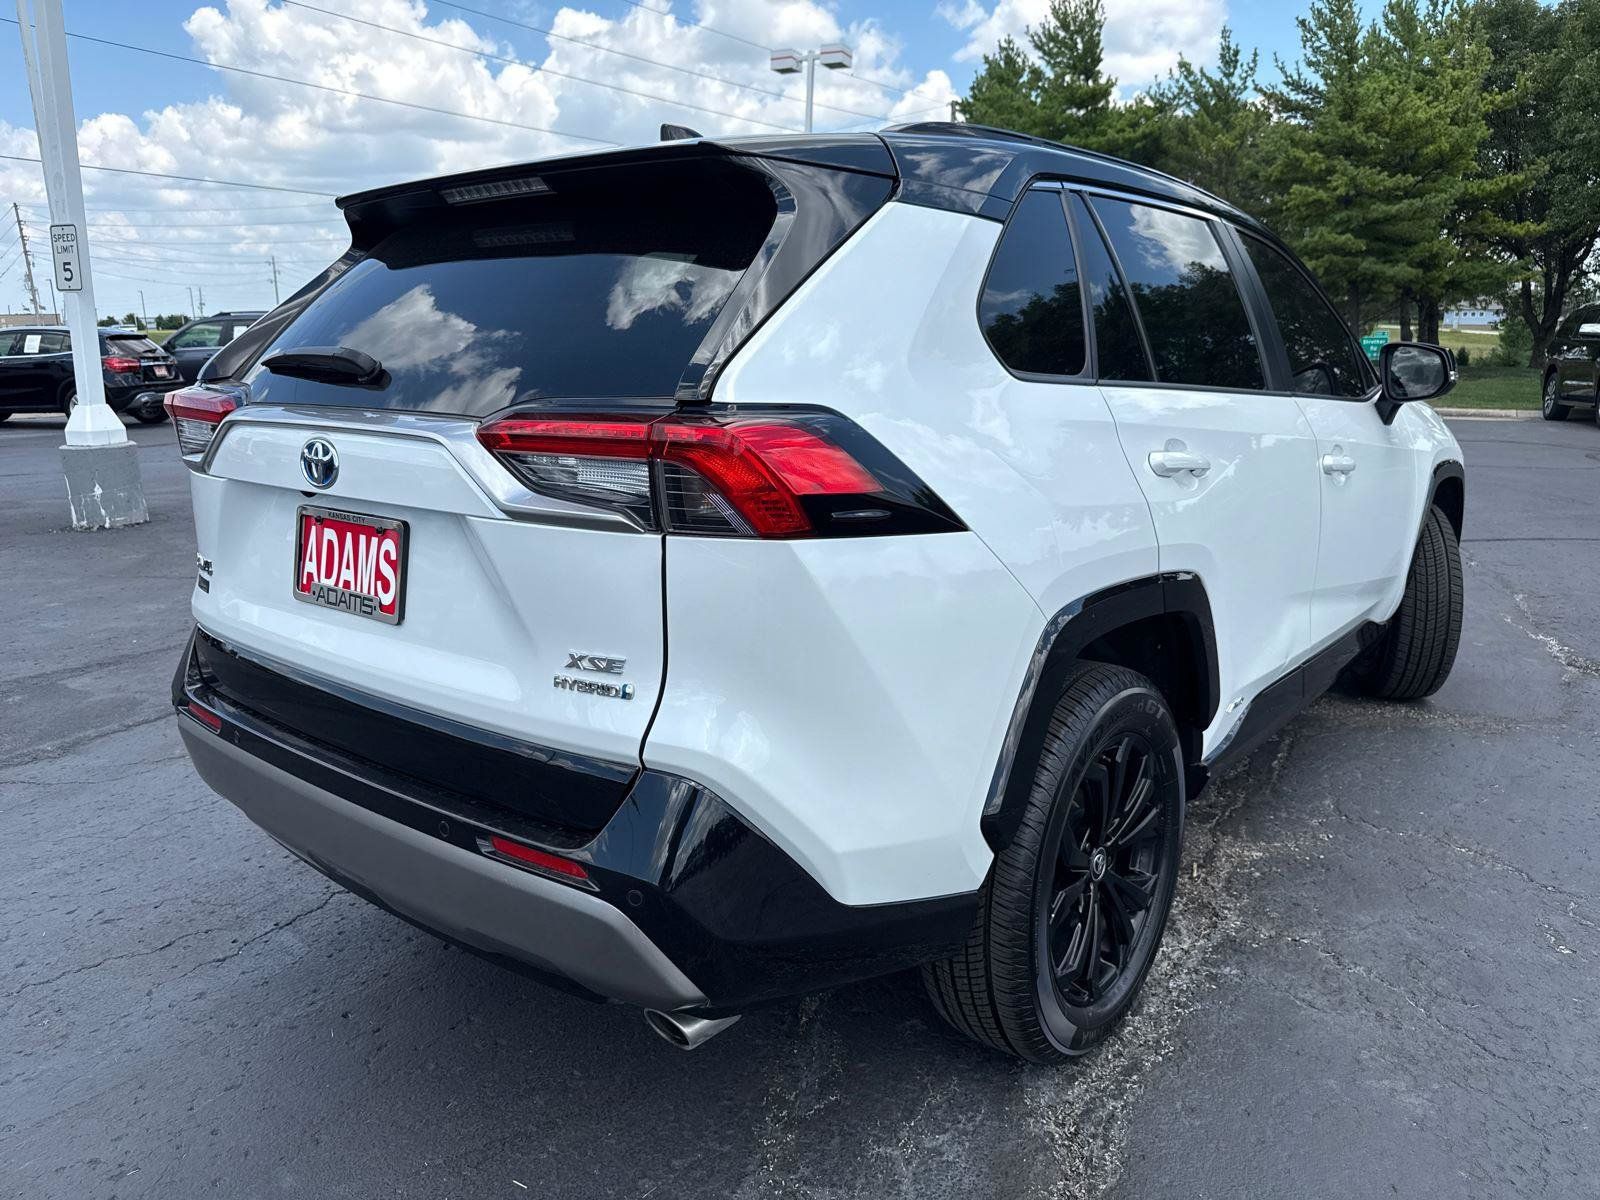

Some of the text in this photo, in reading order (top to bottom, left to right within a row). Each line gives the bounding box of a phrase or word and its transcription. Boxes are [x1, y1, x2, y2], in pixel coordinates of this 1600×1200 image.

[53, 233, 76, 243] SPEED
[56, 245, 74, 254] LIMIT
[62, 262, 74, 282] 5
[328, 511, 366, 523] KANSAS CITY
[303, 525, 397, 606] ADAMS
[316, 586, 374, 615] ADAMS
[565, 652, 627, 674] XSE
[553, 675, 621, 698] HYBRID
